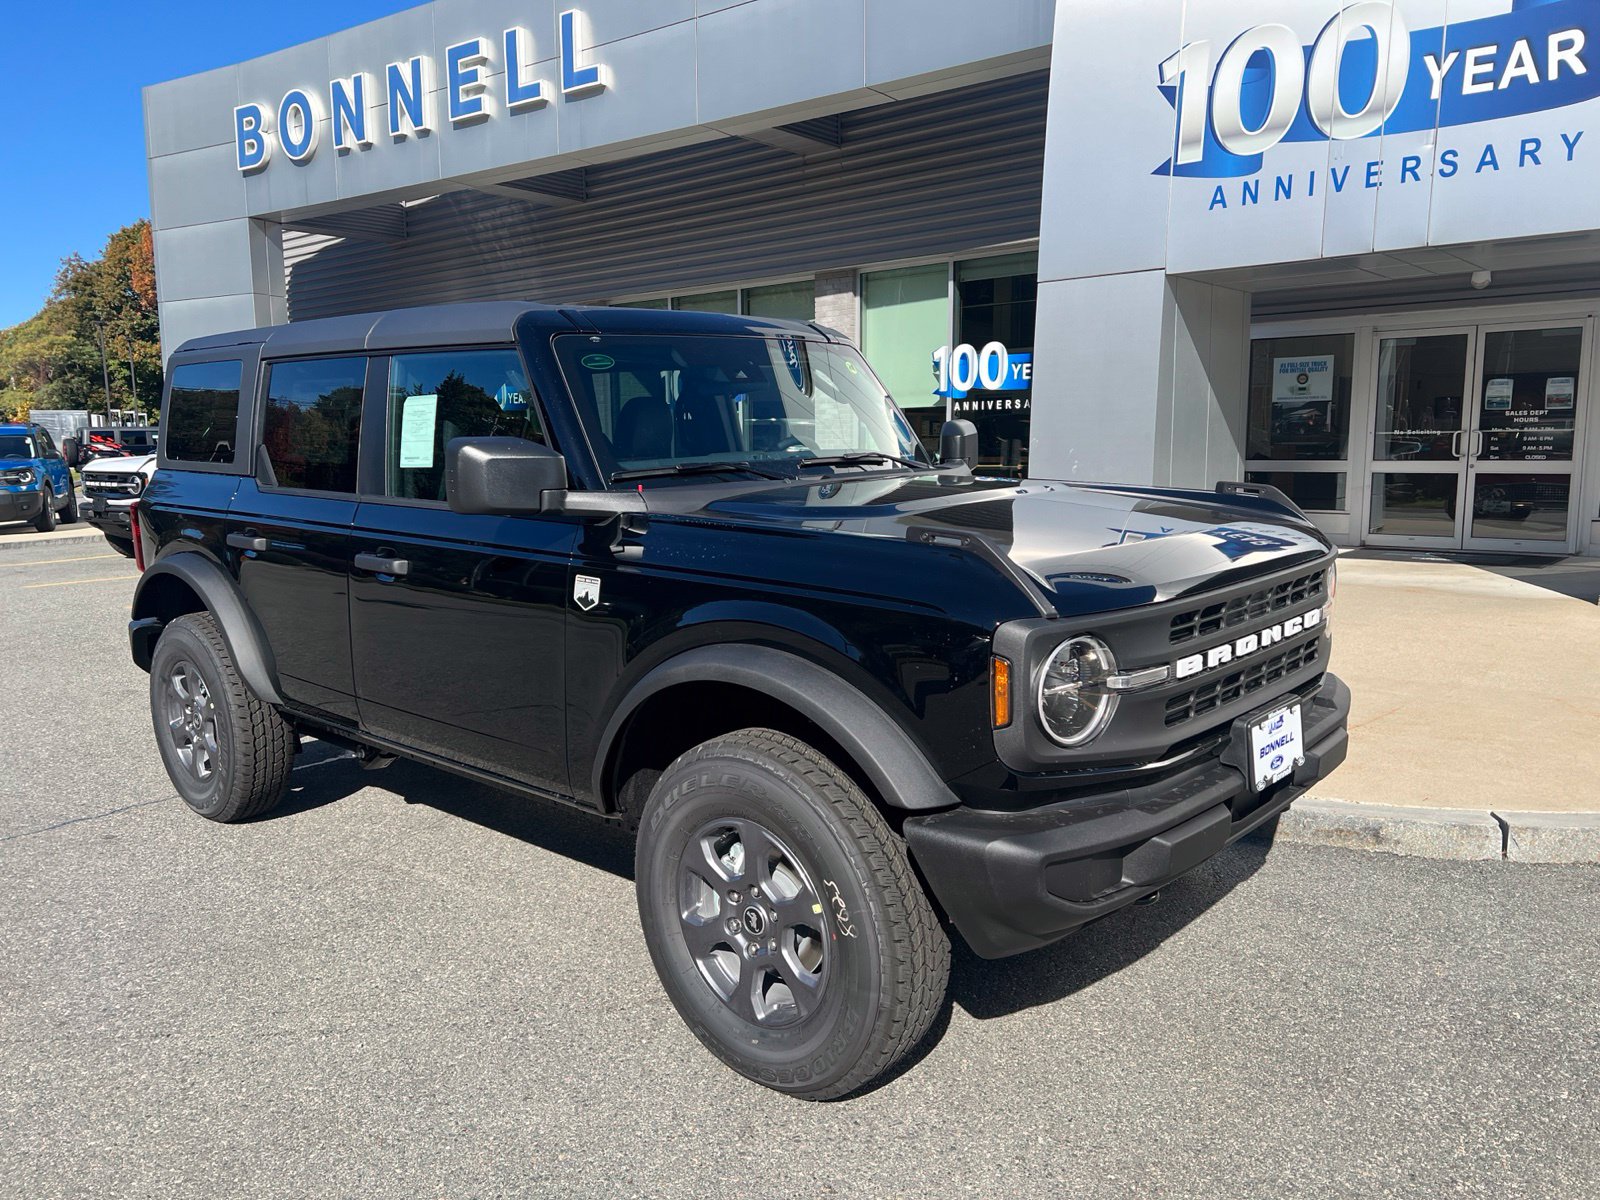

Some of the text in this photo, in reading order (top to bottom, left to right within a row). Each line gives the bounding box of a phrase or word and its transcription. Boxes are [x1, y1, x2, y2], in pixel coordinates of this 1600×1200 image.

[233, 8, 607, 172] BONNELL
[1158, 1, 1588, 165] 100 YEAR
[1209, 131, 1585, 211] ANNIVERSARY
[933, 341, 1009, 392] 100
[1176, 609, 1321, 679] BRONCO
[1260, 732, 1294, 759] BONNELL
